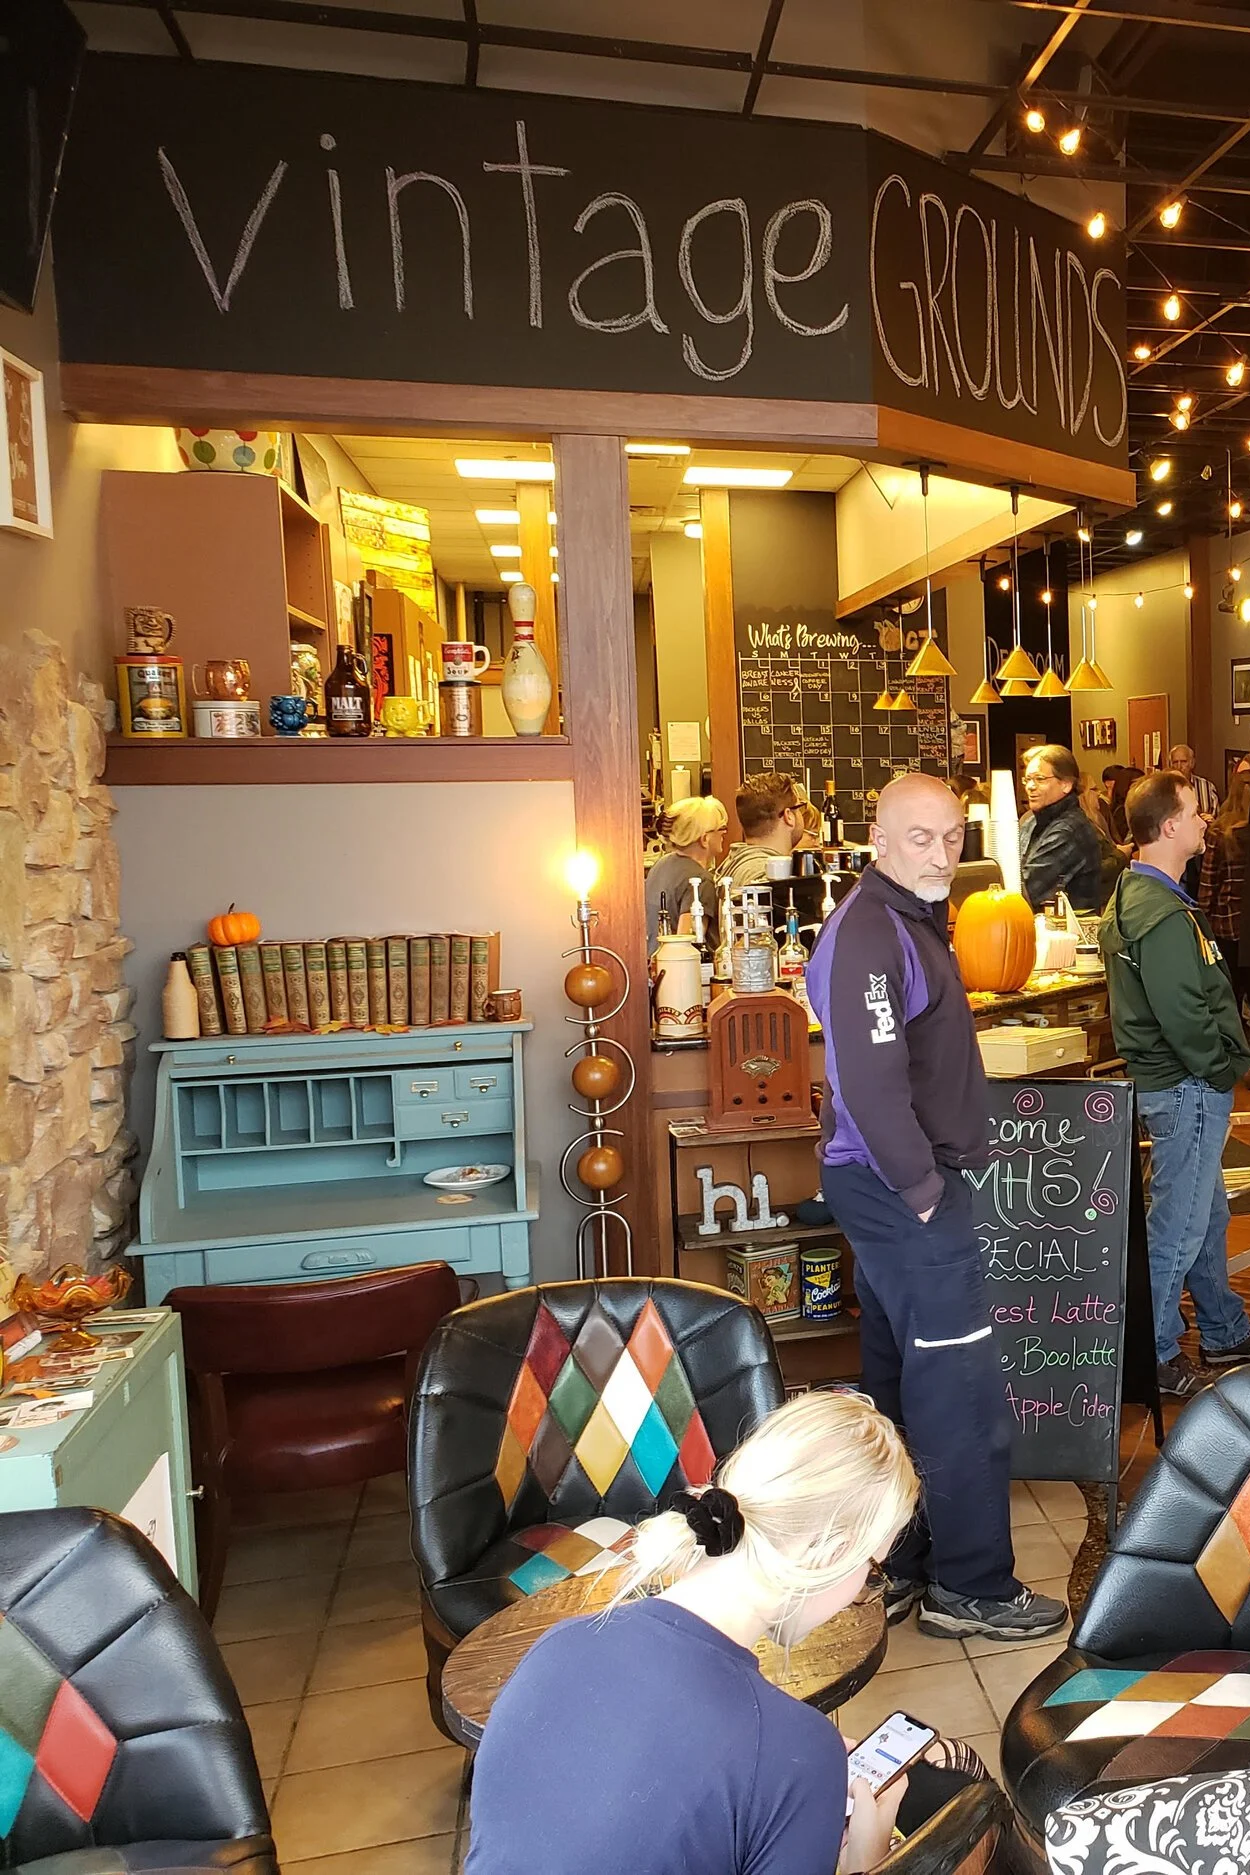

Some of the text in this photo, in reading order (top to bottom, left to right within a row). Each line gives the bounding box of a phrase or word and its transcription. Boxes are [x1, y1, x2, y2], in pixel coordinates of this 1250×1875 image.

[158, 120, 850, 382] vintage
[870, 174, 1128, 447] GROUNDS
[747, 623, 793, 650] What's
[332, 697, 362, 710] MALT
[864, 974, 896, 1043] FedEx
[978, 1236, 1109, 1273] PECIAL:
[1051, 1291, 1119, 1324] Latte
[1015, 1336, 1117, 1376] Boolatte
[1068, 1384, 1115, 1427] Cider
